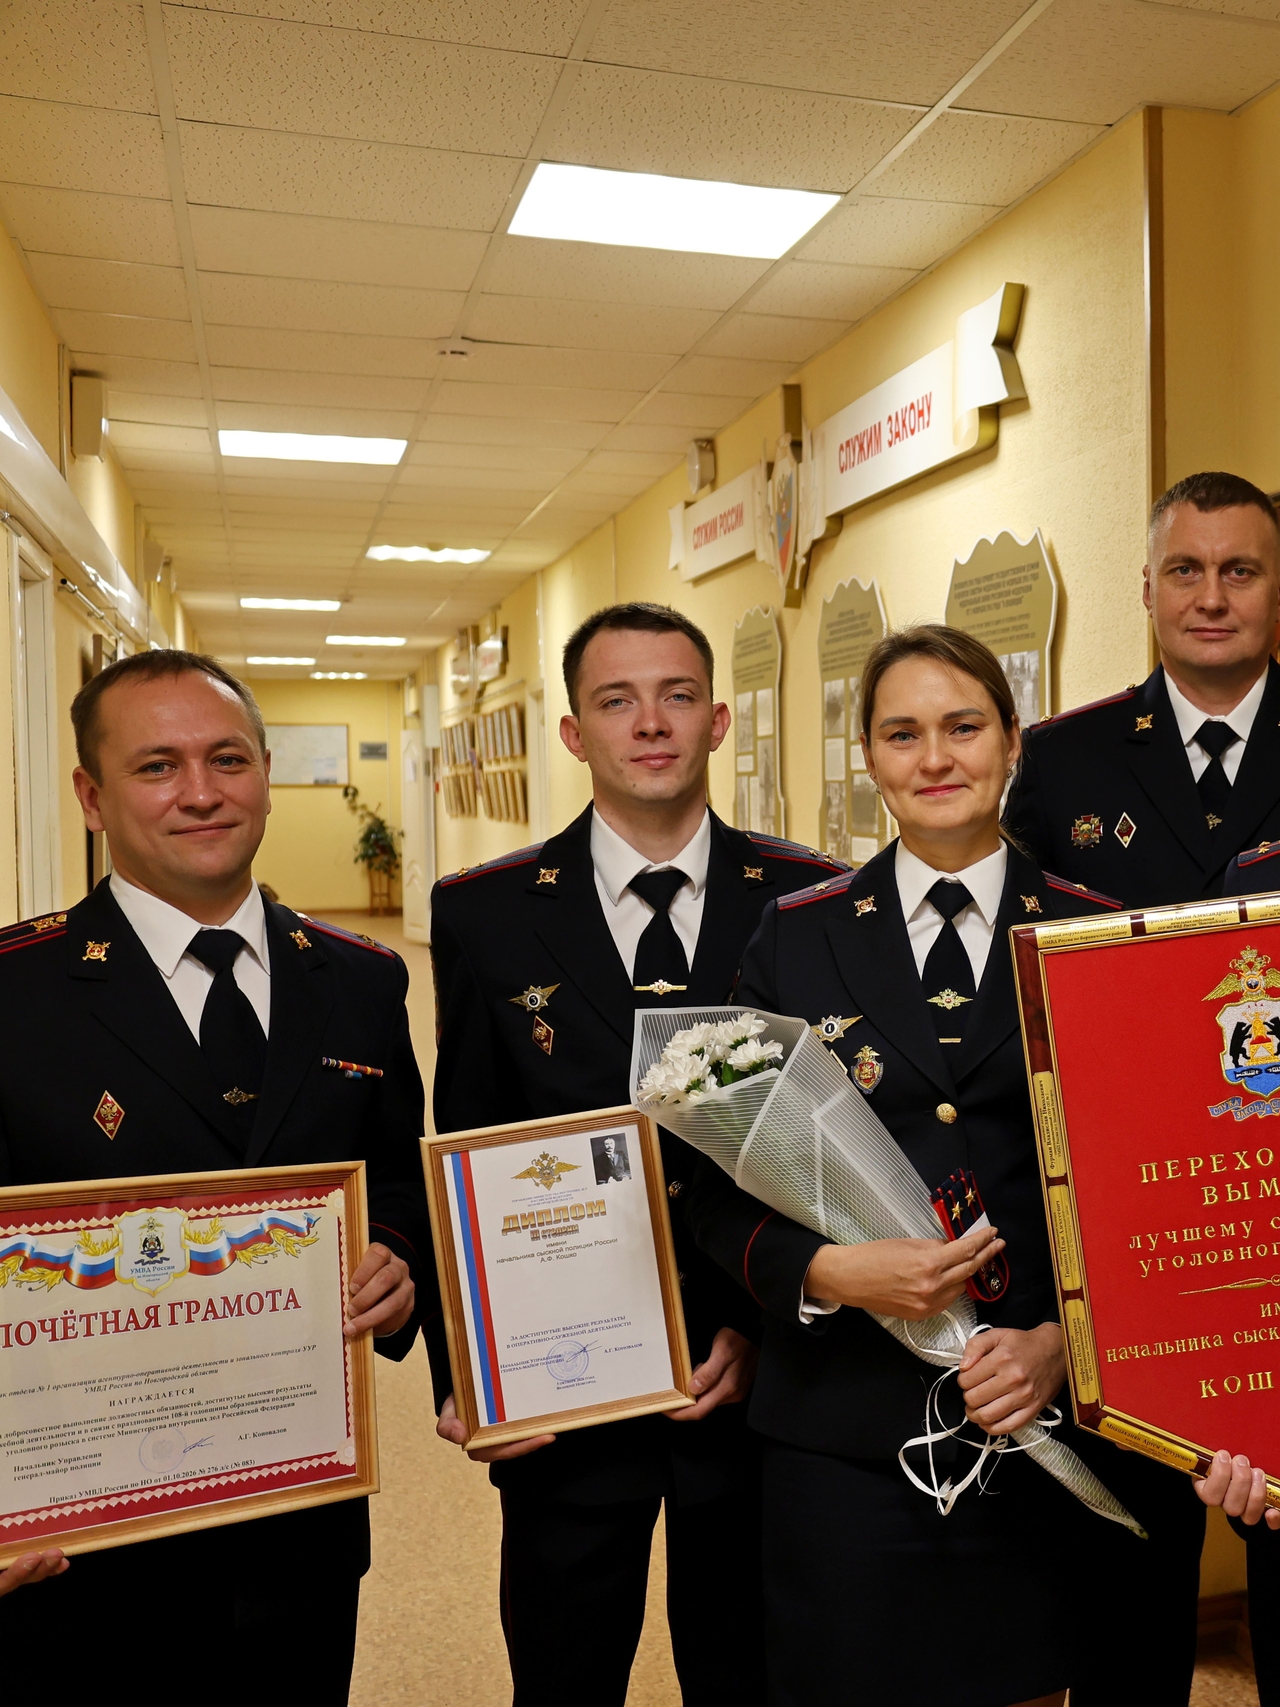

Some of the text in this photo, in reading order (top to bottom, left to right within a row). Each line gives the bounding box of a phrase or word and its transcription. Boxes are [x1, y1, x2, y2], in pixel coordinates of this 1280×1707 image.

[839, 391, 932, 474] СЛУЖИМ ЗАКОНУ
[693, 502, 744, 550] СЛУЖИМ РОССИИ
[1213, 1098, 1240, 1115] СЛУЖА
[1236, 1103, 1265, 1119] ЗАКОНУ
[501, 1198, 607, 1236] ДИПЛОМ
[1130, 1221, 1253, 1252] лучшему
[496, 1238, 617, 1263] начальника сыскной полиции России
[130, 1265, 150, 1274] УМВД
[0, 1288, 302, 1348] ПОЧЁТНАЯ ГРАМОТА
[1106, 1335, 1223, 1362] начальника
[84, 1368, 218, 1393] УМВД России Новгородской области
[109, 1386, 194, 1407] НАГРАЖДАЕТСЯ
[238, 1427, 286, 1440] А.Г. Коновалов
[13, 1452, 101, 1472] Начальник Управления
[13, 1461, 100, 1480] генерал-майор полиции
[49, 1493, 76, 1504] Приказ
[78, 1486, 102, 1497] УМВД
[104, 1483, 128, 1492] России
[140, 1477, 152, 1486] НО
[241, 1458, 255, 1467] 083)
